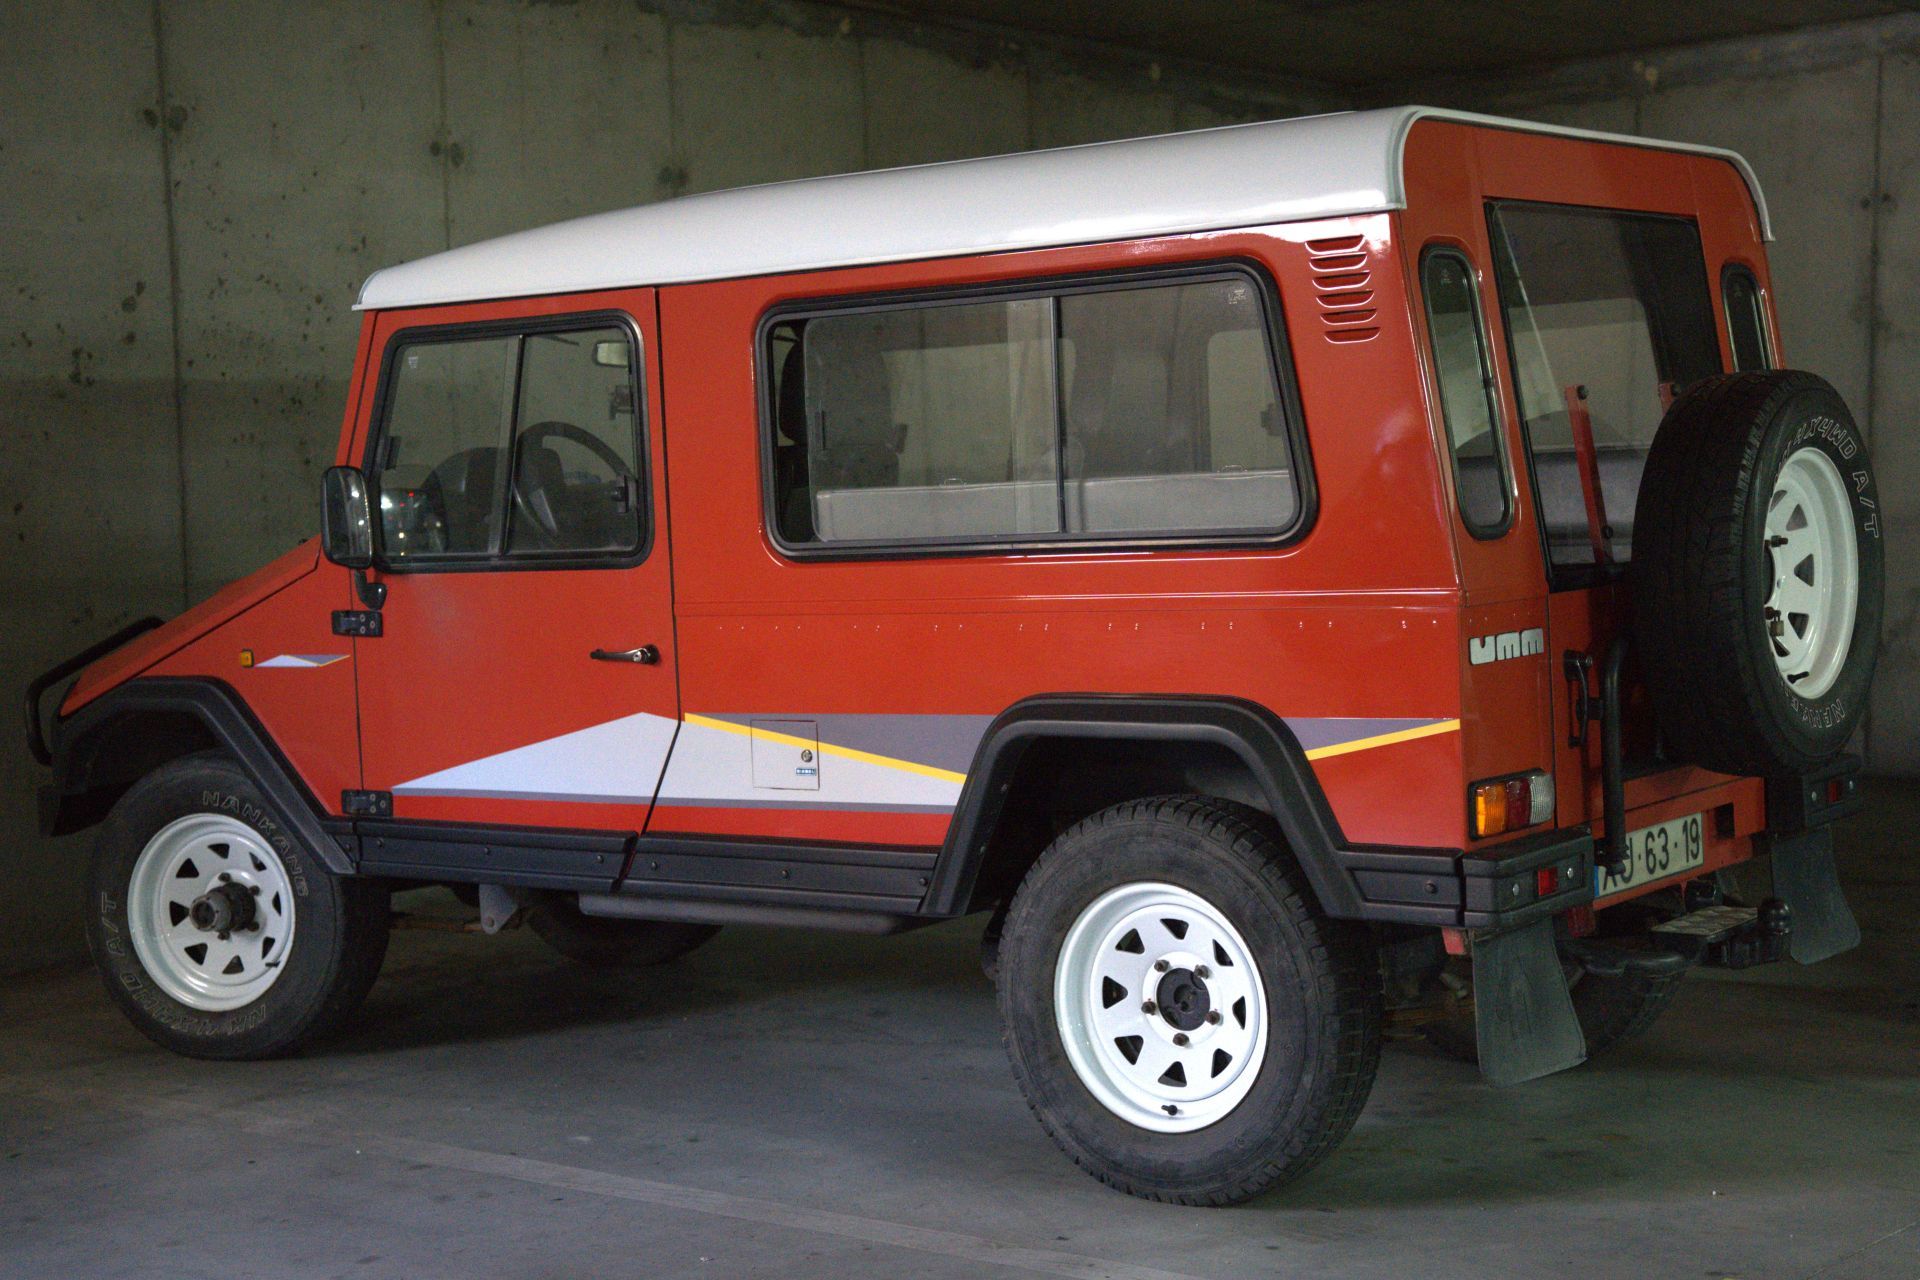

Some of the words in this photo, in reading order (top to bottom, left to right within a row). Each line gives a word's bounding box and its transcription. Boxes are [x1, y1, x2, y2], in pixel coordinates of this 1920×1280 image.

[1852, 470, 1880, 539] A/T
[202, 790, 309, 898] NANKANG
[101, 891, 127, 956] A/T
